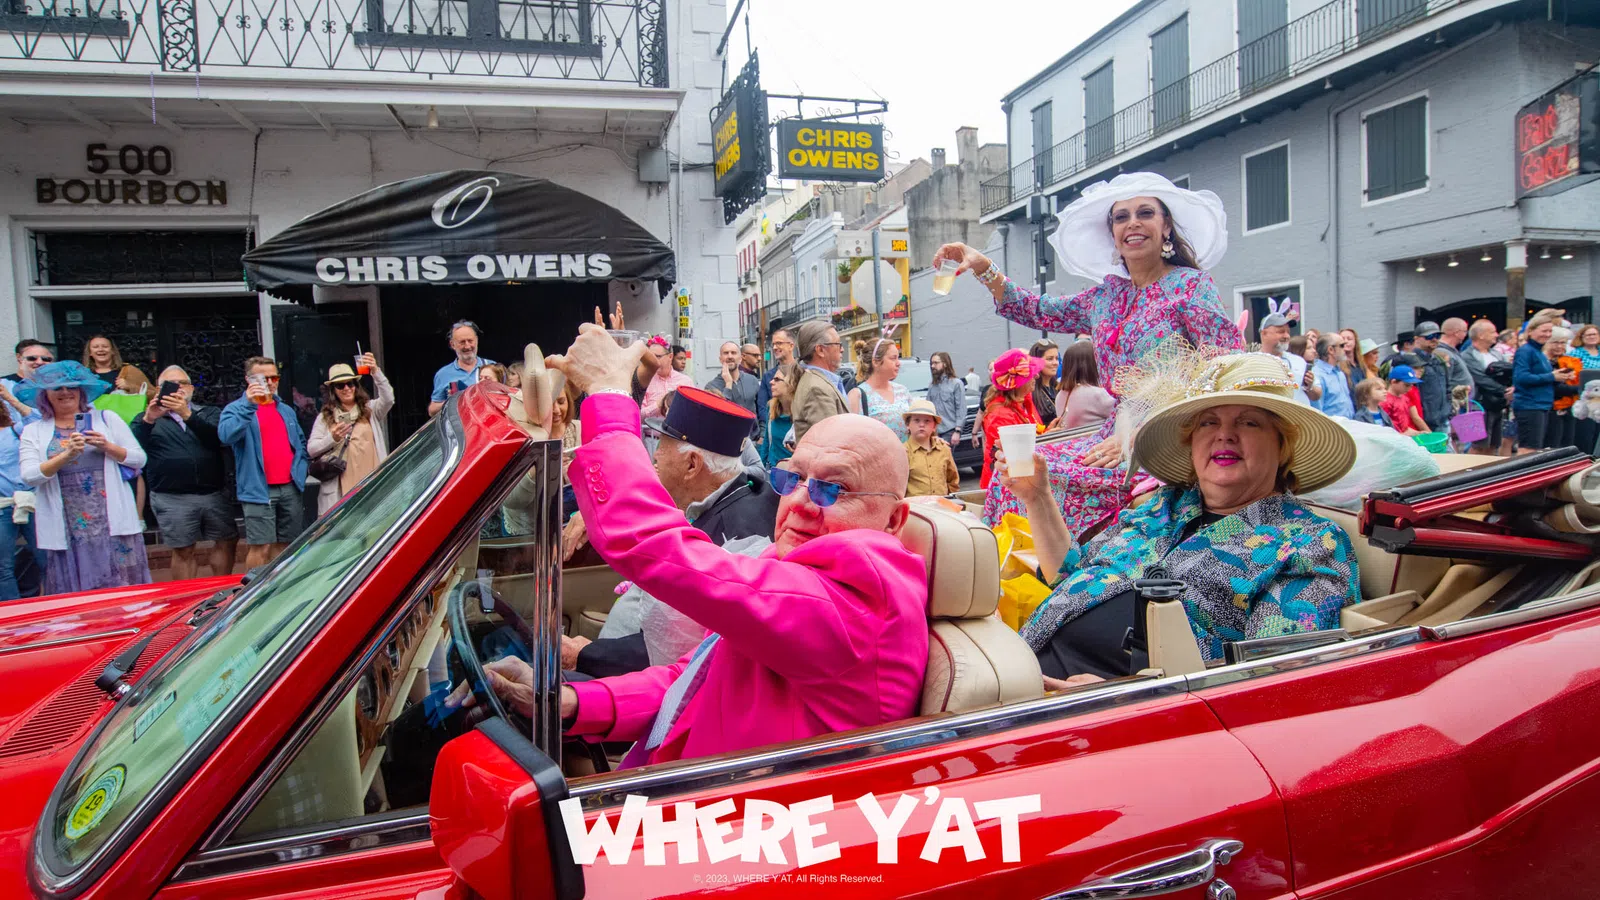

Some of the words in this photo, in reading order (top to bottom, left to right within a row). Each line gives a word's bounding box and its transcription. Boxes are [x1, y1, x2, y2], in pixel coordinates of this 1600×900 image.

[716, 111, 737, 153] CHRIS
[797, 128, 873, 149] CHRIS
[86, 143, 172, 175] 500
[716, 137, 741, 181] OWENS
[788, 148, 879, 171] OWENS
[36, 178, 228, 205] BOURBON
[315, 254, 449, 283] CHRIS
[466, 253, 613, 280] OWENS
